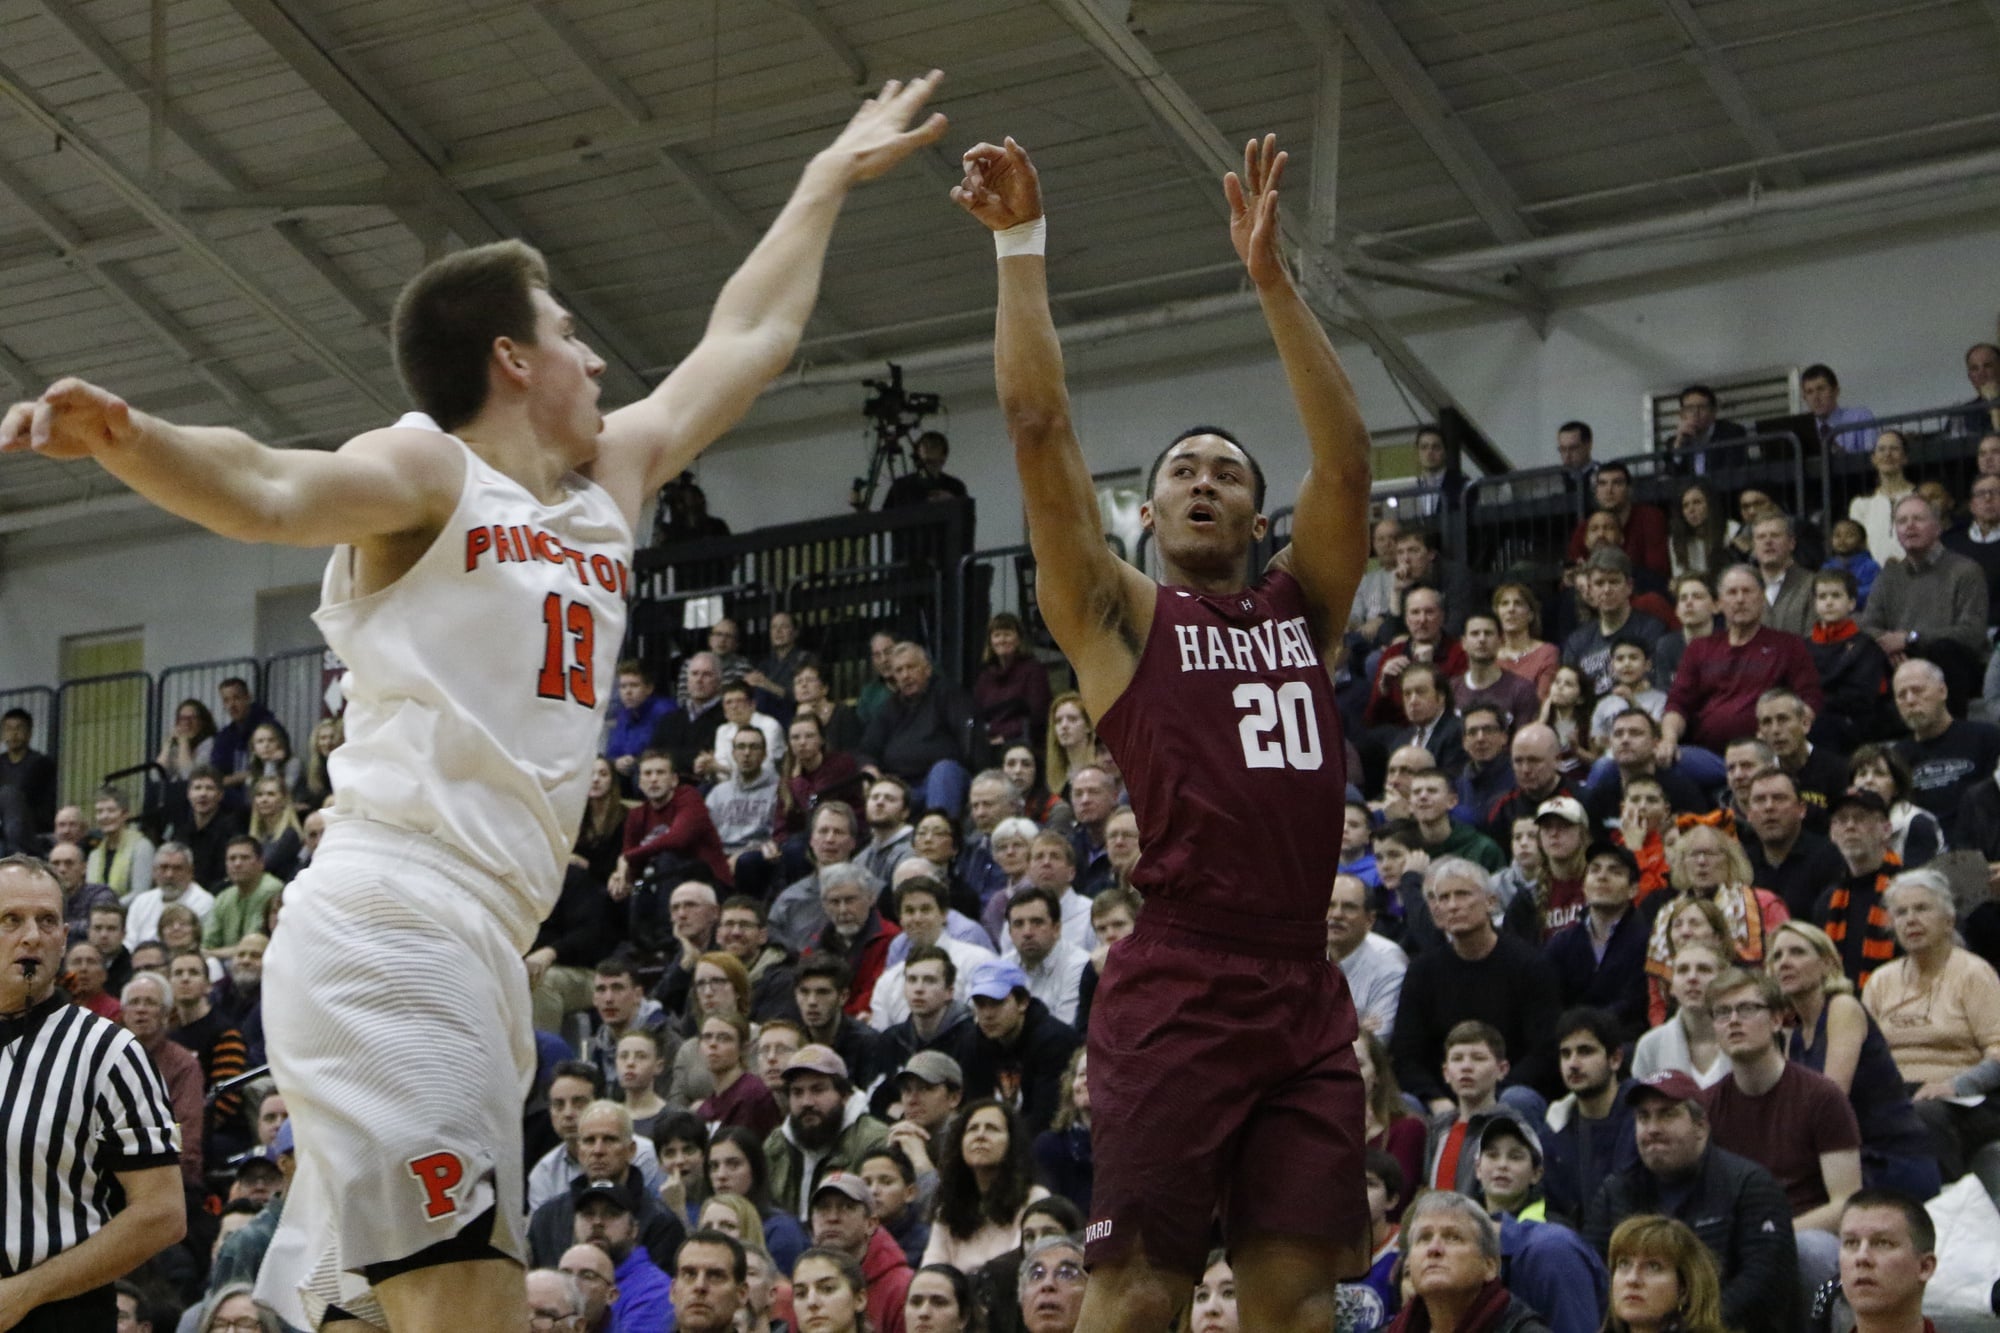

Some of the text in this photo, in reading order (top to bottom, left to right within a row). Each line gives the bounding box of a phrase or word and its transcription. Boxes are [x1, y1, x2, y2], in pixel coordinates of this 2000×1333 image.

[465, 524, 628, 600] PRICTO
[537, 591, 596, 709] 13
[1232, 681, 1324, 770] 20
[408, 1151, 463, 1219] P
